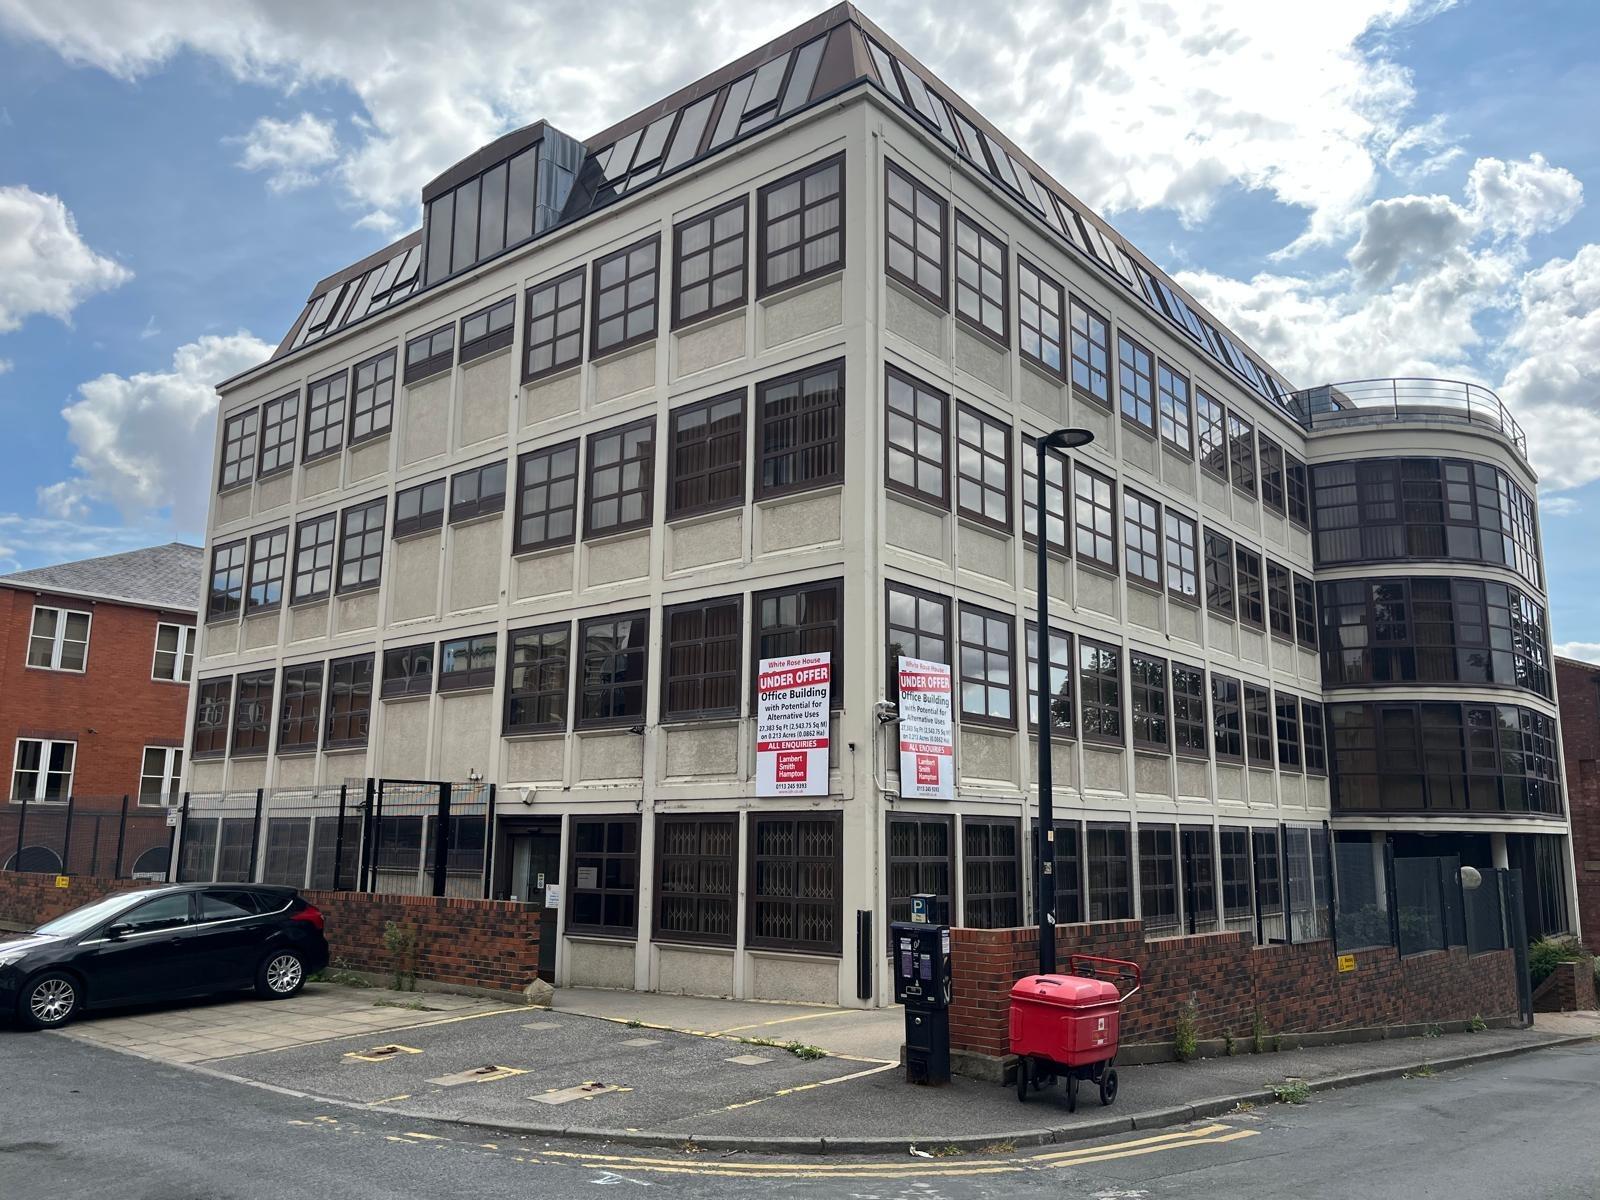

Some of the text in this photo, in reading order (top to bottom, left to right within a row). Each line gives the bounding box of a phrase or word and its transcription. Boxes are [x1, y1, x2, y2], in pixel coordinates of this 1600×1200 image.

[760, 668, 828, 689] UNDER OFFER
[900, 676, 950, 688] UNDER OFFER
[761, 687, 827, 701] Office Building
[901, 691, 949, 708] Office Building
[781, 701, 810, 710] Potential
[917, 706, 938, 714] Potential
[767, 712, 803, 721] Alternative
[907, 714, 934, 724] Alternative
[813, 721, 820, 729] Sq
[782, 740, 817, 750] ENQUIRIES
[909, 743, 945, 754] ALL ENQUIRIES
[918, 758, 936, 766] Lambert
[918, 773, 937, 781] Hampton
[913, 900, 923, 913] P
